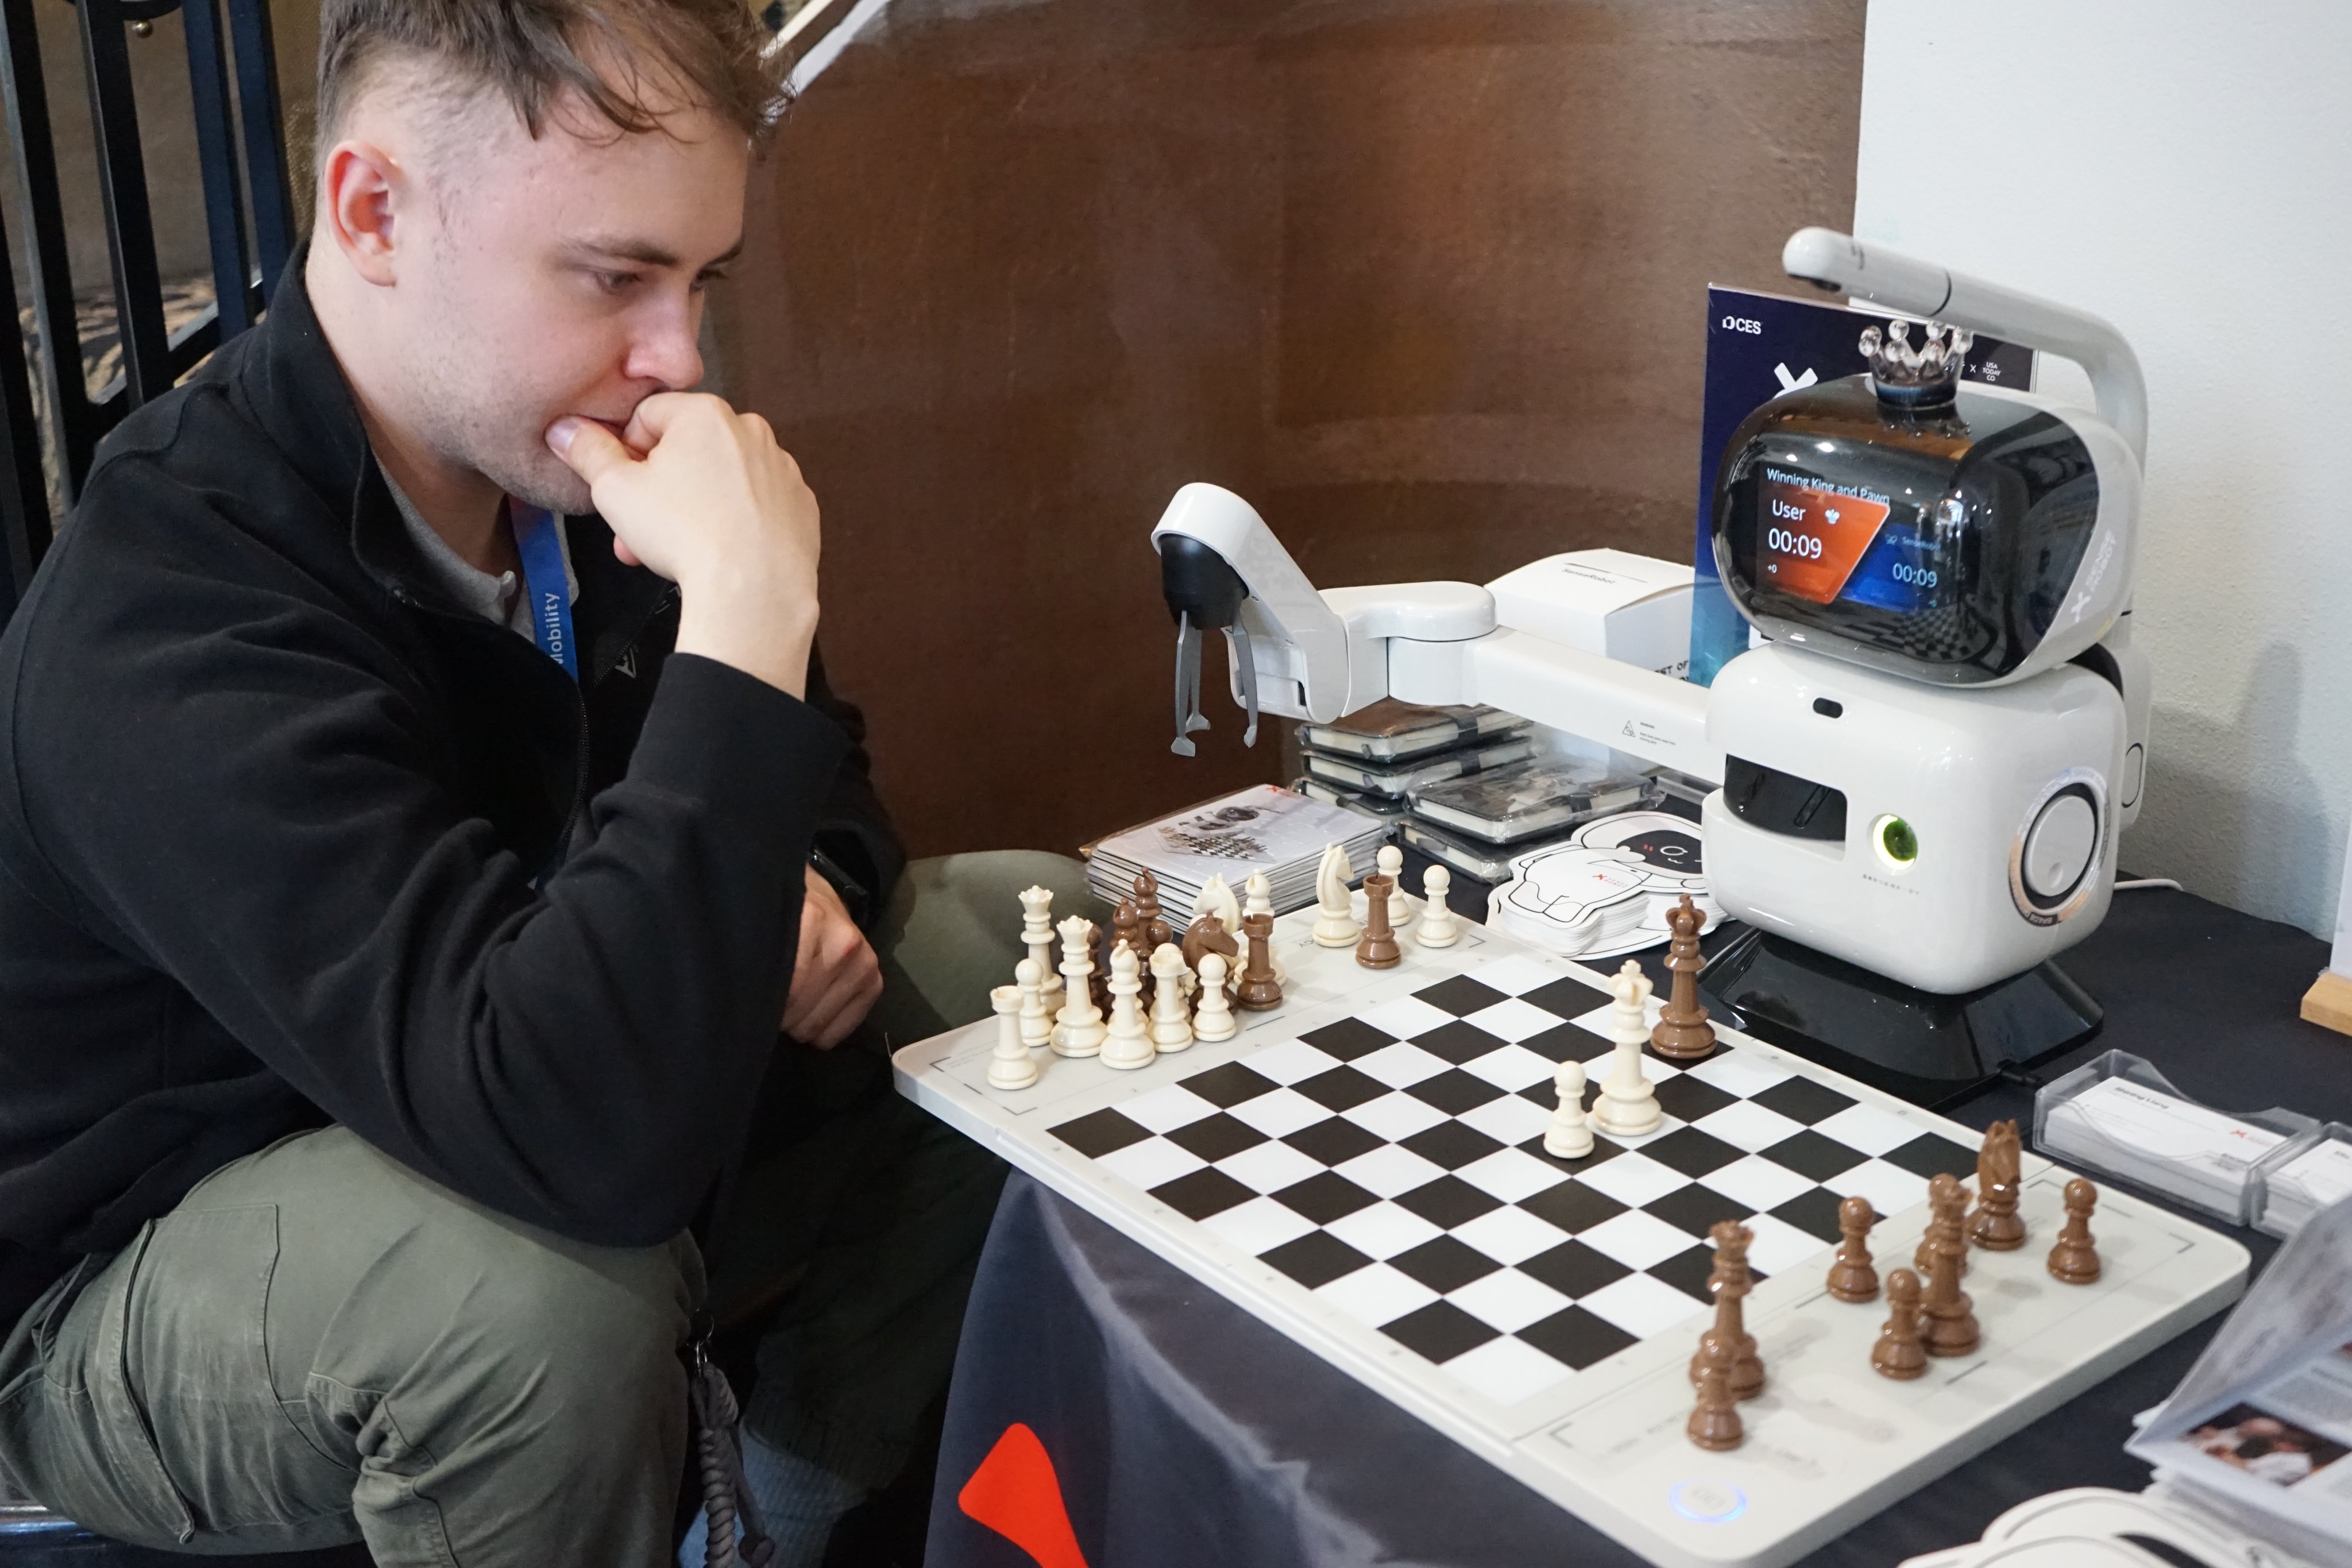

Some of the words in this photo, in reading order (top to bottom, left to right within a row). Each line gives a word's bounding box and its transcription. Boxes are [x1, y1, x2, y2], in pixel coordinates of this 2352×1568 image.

[1736, 318, 1762, 334] CES
[1982, 367, 2001, 376] TODAY
[1767, 468, 1809, 491] Winning
[1811, 477, 1835, 496] King
[1837, 485, 1857, 498] and
[1860, 487, 1890, 505] Pawn
[1772, 499, 1806, 521] User
[1768, 528, 1822, 559] 00:09
[1893, 562, 1937, 588] 00:09
